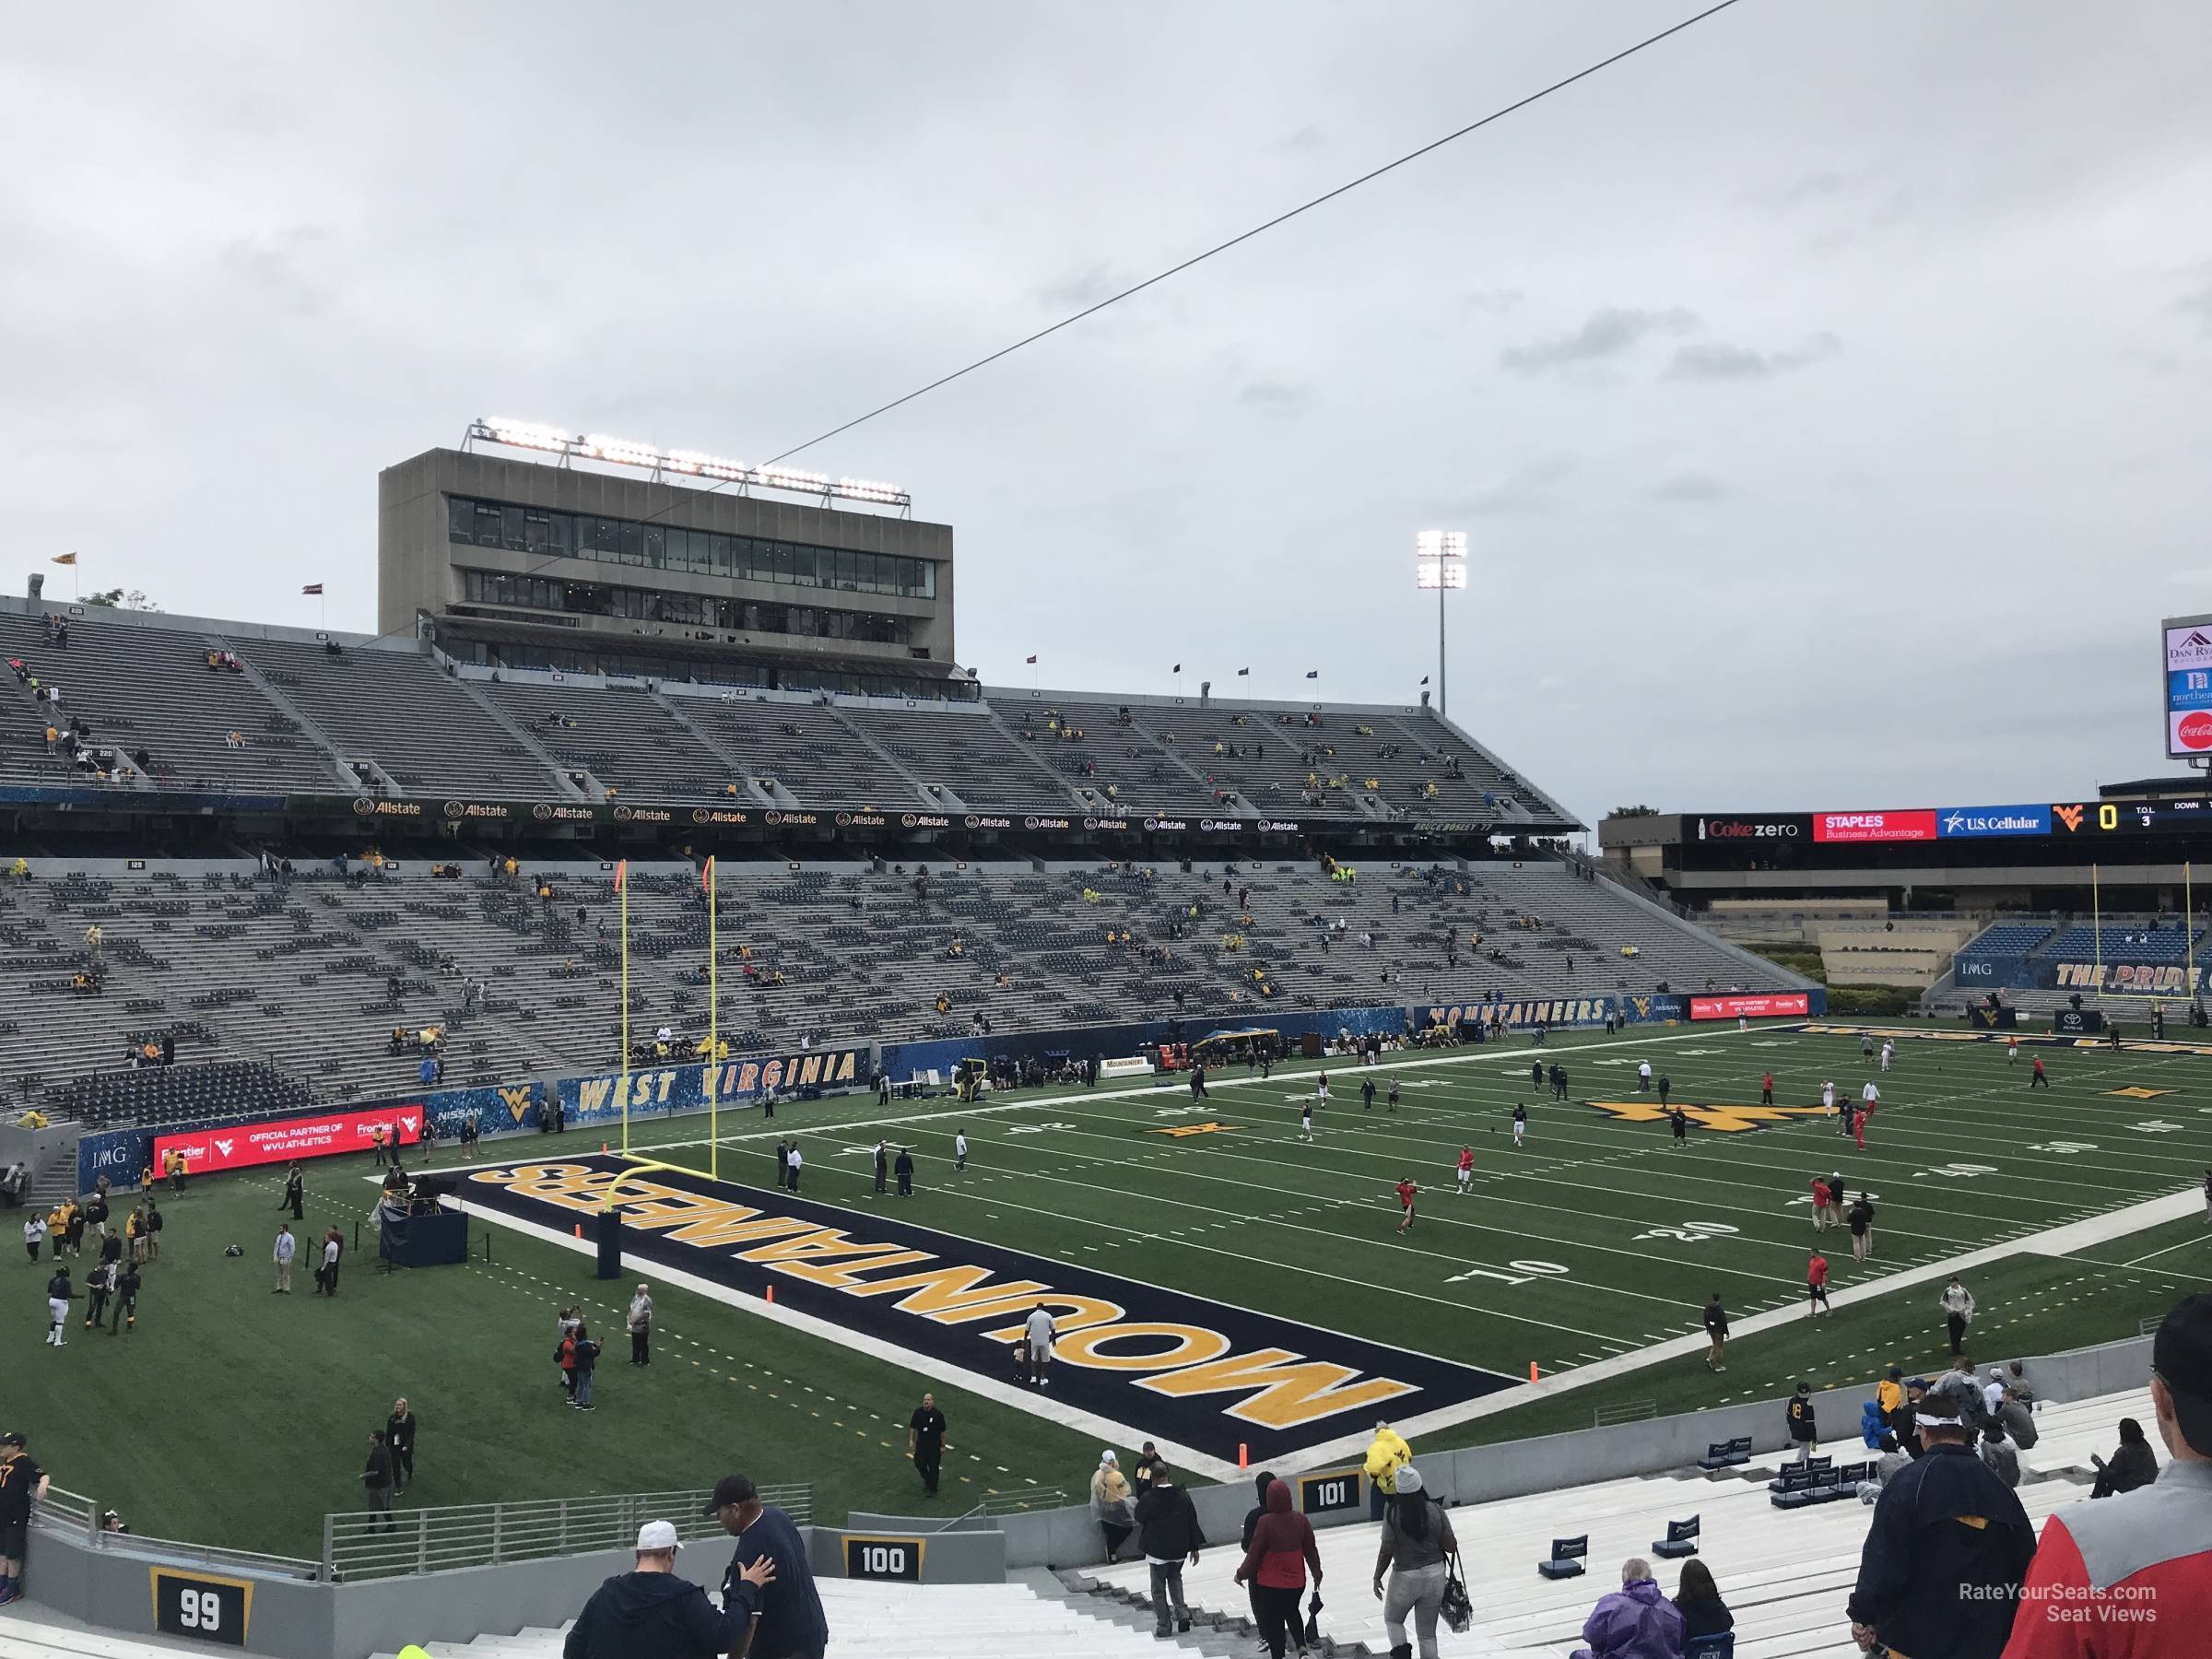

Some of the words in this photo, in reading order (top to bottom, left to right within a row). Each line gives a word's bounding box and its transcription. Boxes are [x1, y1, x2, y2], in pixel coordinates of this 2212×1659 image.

[375, 802, 420, 816] Allstate
[465, 805, 507, 817] Allstate
[2174, 802, 2199, 810] DOWN
[551, 807, 593, 819] Allstate
[631, 810, 670, 821] Allstate
[710, 811, 747, 823] Allstate
[782, 813, 817, 824] Allstate
[2100, 805, 2117, 830] 0
[852, 815, 885, 826] Allstate
[917, 817, 949, 827] Allstate
[979, 818, 1010, 828] Allstate
[1039, 818, 1069, 829] Allstate
[1098, 820, 1127, 830] Allstate
[1157, 820, 1186, 830] Allstate
[1213, 821, 1241, 830] Allstate
[1271, 822, 1298, 831] Allstate
[1826, 816, 1884, 829] STAPLES
[1967, 818, 1987, 830] U.S.
[1991, 817, 2040, 830] Cellular
[2142, 816, 2150, 827] 3
[1826, 830, 1867, 839] Business
[1869, 829, 1924, 839] Advantage
[1962, 962, 1992, 976] IMG
[2057, 964, 2108, 985] THE
[2110, 966, 2202, 991] PRIDE
[1429, 999, 1605, 1027] MOUNTAINEERS
[579, 1071, 677, 1112] WEST
[702, 1052, 855, 1097] VIRGINIA
[437, 1107, 483, 1122] NISSAN
[249, 1130, 288, 1143] OFFICIAL
[289, 1124, 330, 1138] PARTNER
[330, 1123, 344, 1134] OF
[262, 1142, 285, 1152] WVU
[286, 1135, 332, 1149] ATHLETICS
[2027, 1141, 2099, 1155] 50
[92, 1147, 127, 1170] IMG
[1927, 1163, 1999, 1178] 40
[1647, 1221, 1740, 1242] 20
[1464, 1260, 1570, 1286] 10
[468, 1163, 1421, 1431] MOUNTAINEERS
[1317, 1480, 1346, 1506] 101
[863, 1547, 905, 1573] 100
[181, 1588, 220, 1631] 99
